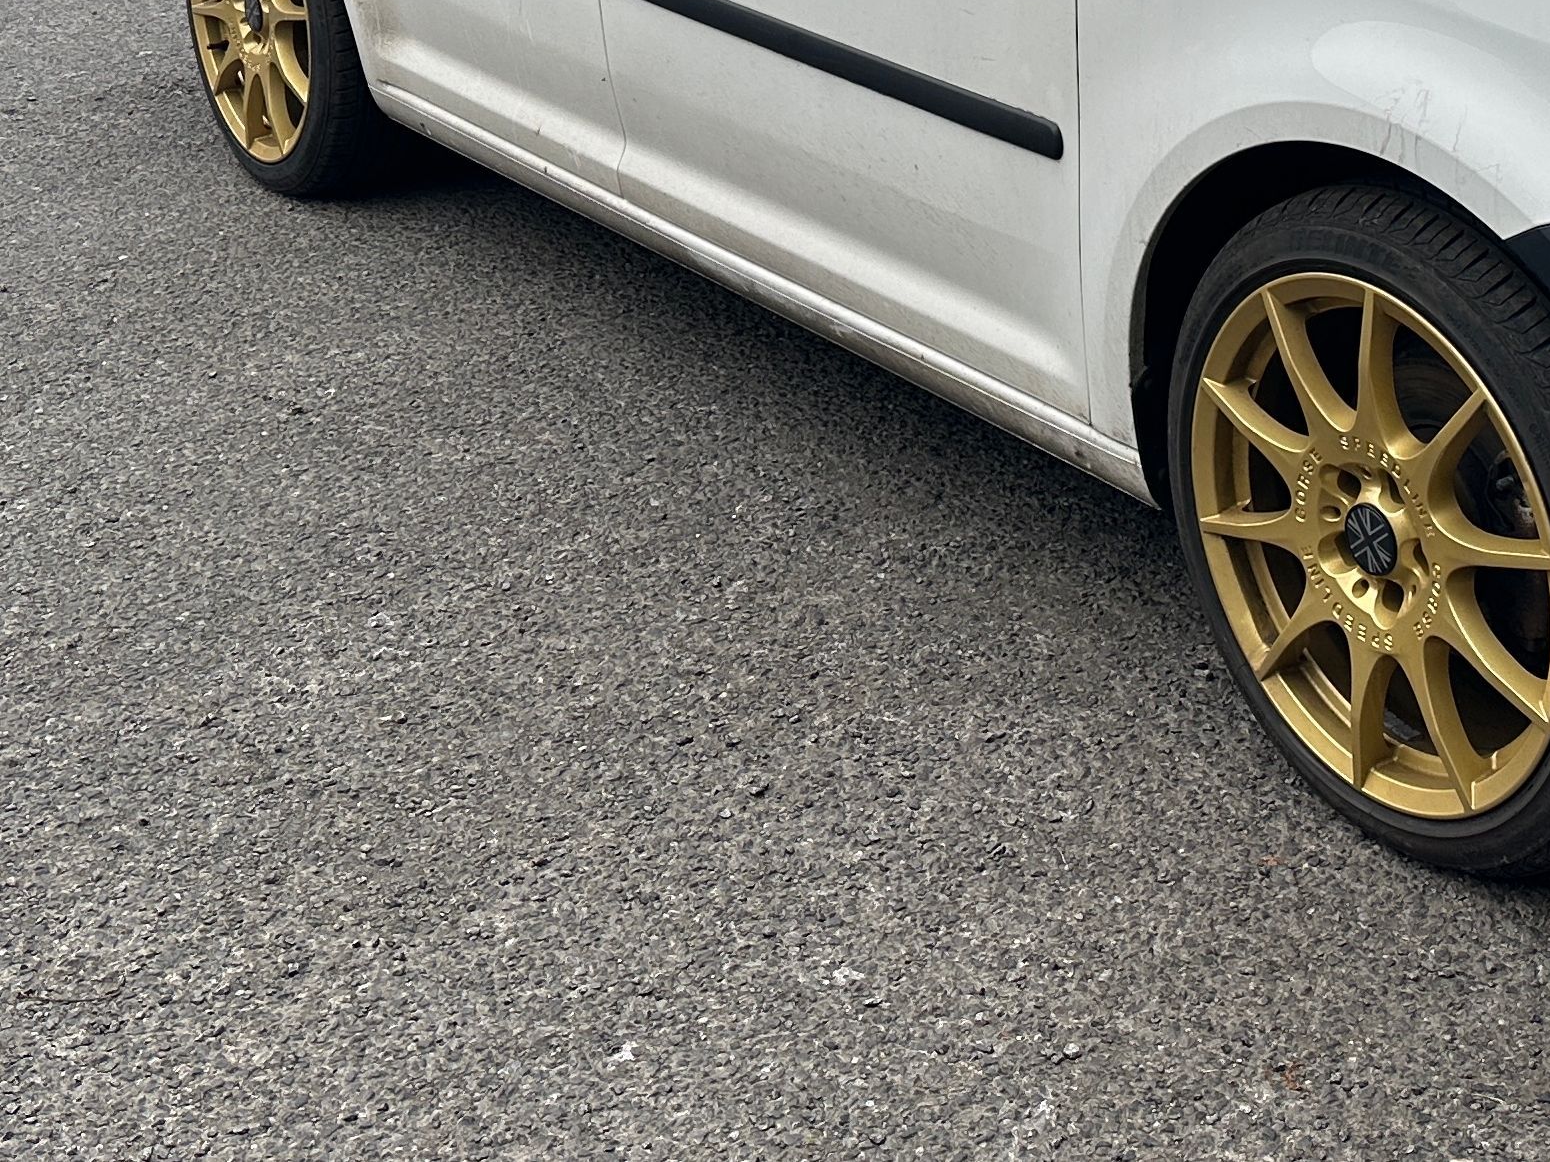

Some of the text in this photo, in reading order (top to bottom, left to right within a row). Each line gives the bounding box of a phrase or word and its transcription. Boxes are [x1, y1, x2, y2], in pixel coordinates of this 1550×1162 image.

[1295, 447, 1324, 523] CORSE
[1338, 434, 1436, 539] SPEEDLINE
[1300, 544, 1394, 651] SPEEDLINE
[1412, 561, 1442, 641] CORSE
